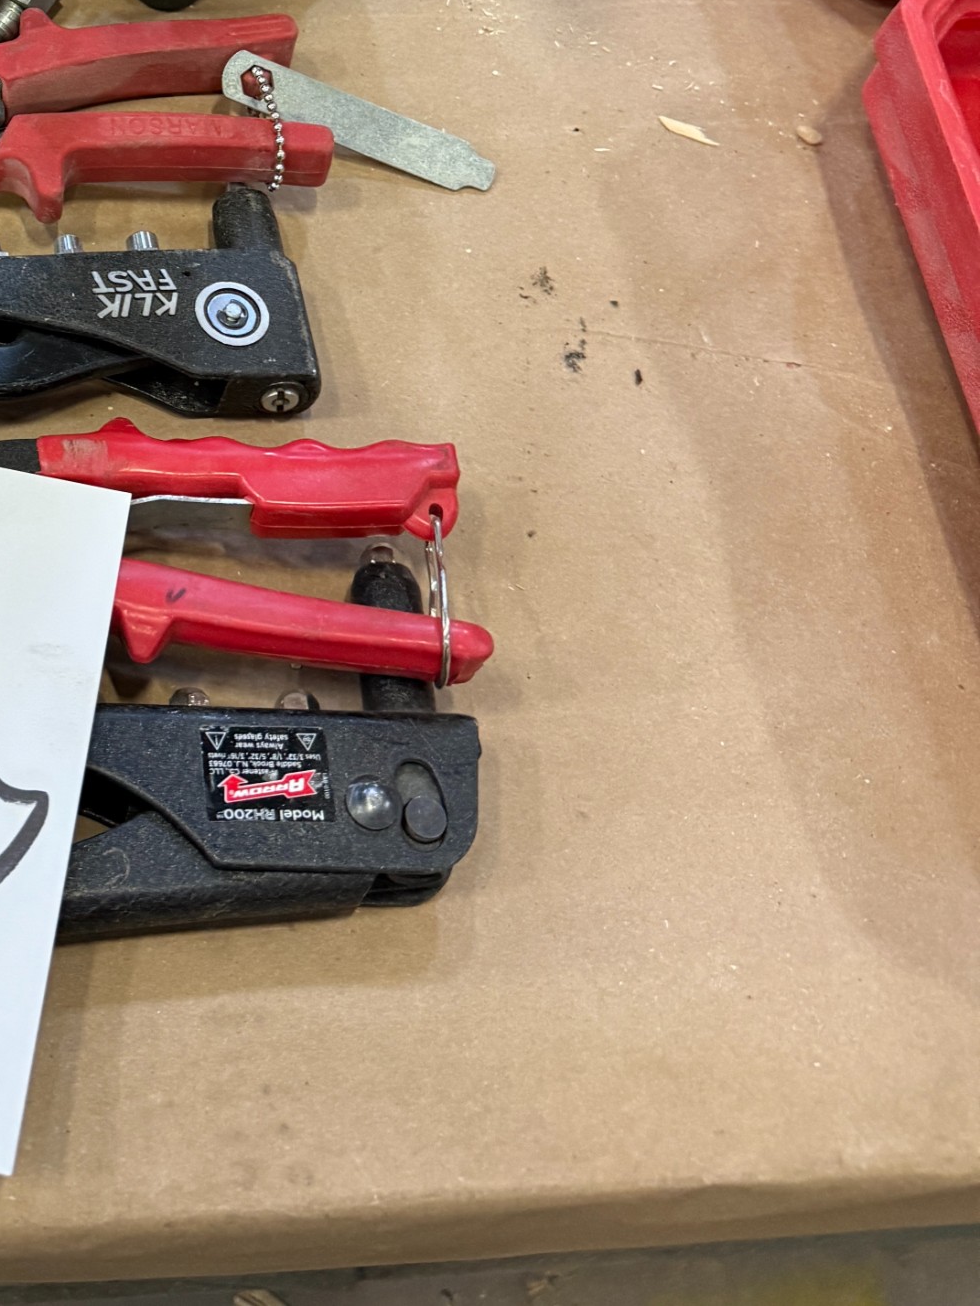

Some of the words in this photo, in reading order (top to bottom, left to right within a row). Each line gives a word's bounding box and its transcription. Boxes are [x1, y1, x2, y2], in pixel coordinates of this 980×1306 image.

[91, 268, 177, 294] FAST
[96, 292, 179, 319] KLIK
[233, 732, 262, 741] glasses
[264, 733, 289, 742] safety
[256, 741, 284, 750] Always
[305, 753, 322, 761] Uses
[250, 760, 275, 768] Brook,
[276, 760, 302, 768] Saddle
[209, 767, 225, 775] LLC
[280, 809, 325, 821] Model
